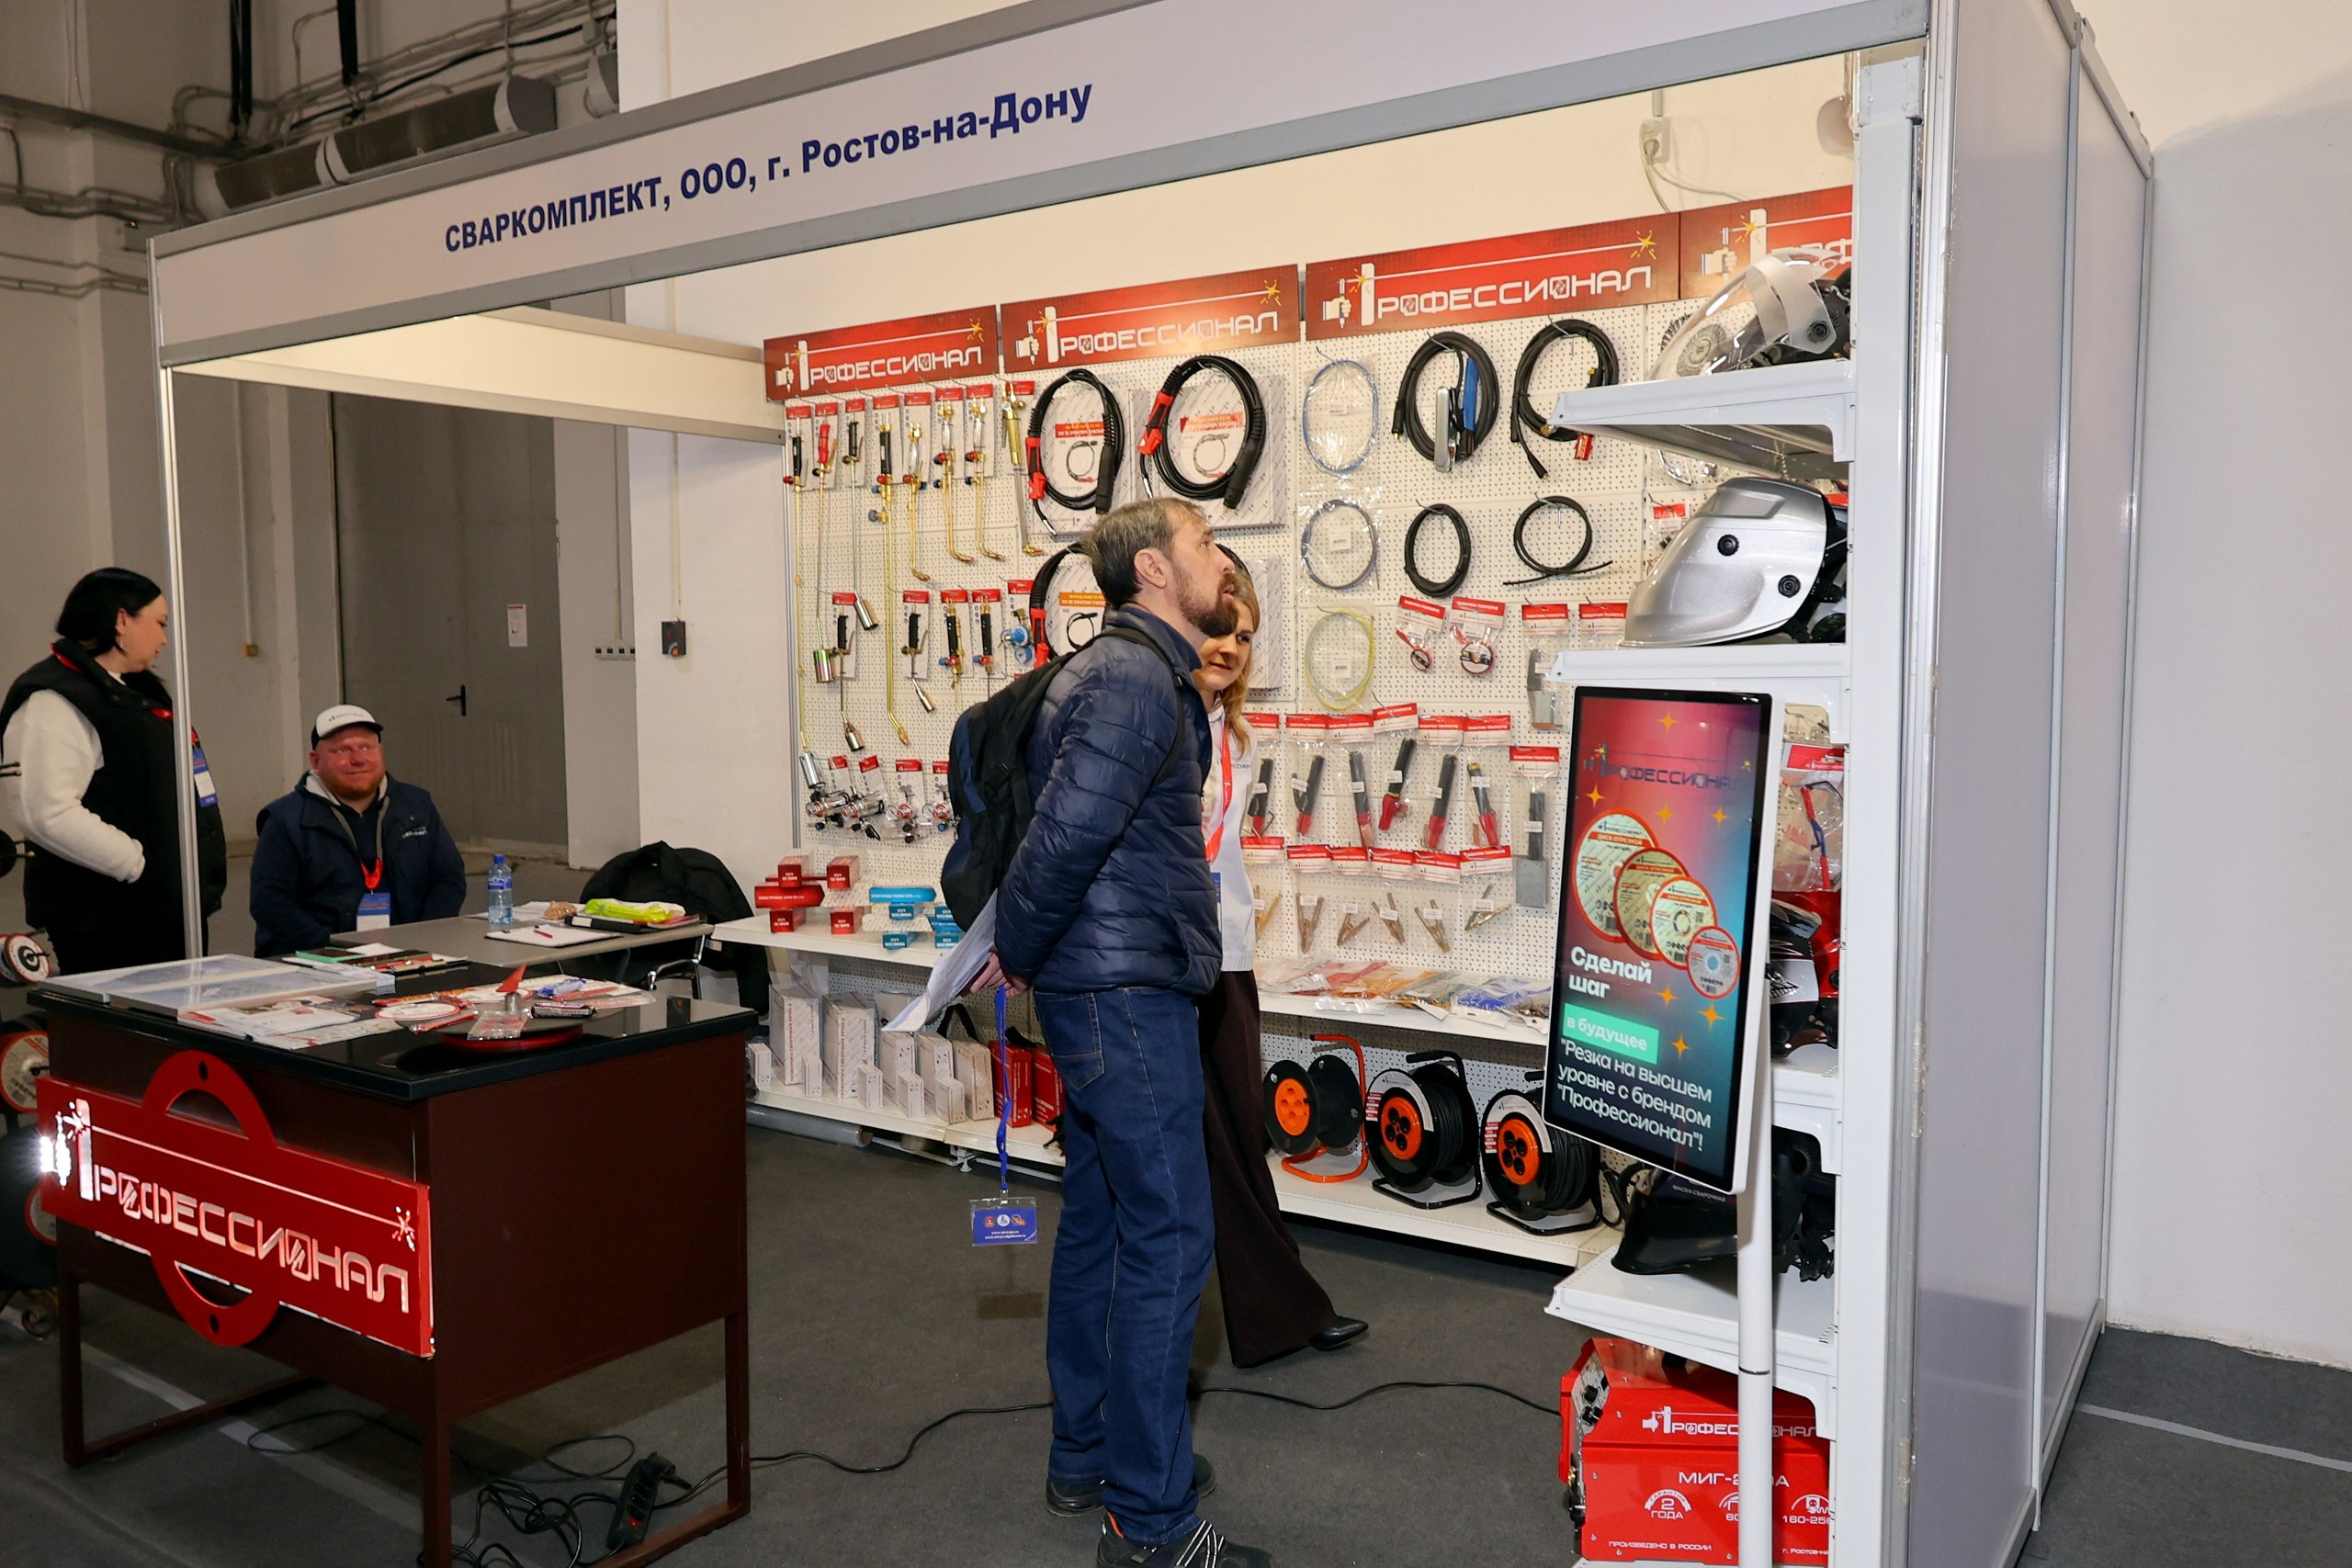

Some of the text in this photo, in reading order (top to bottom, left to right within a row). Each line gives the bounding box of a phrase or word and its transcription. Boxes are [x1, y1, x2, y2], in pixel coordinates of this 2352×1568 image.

[445, 84, 1092, 253] СВАРКОМПЛЕКТ, ООО, г. Ростов-на-Дону
[1584, 741, 1746, 792] ПРОФЕССИОНА
[1571, 946, 1652, 984] Сделай
[1568, 974, 1610, 998] шаг
[1566, 1016, 1647, 1051] в будущее
[1561, 1037, 1713, 1102] "Резка на высшем
[1558, 1064, 1711, 1129] уровне с брендом
[1557, 1083, 1703, 1152] "Профессионал"!
[1651, 1510, 1684, 1520] ГОДА
[1660, 1498, 1675, 1511] 2
[1609, 1540, 1668, 1551] ПРОИЗВЕДЕНО
[1678, 1542, 1712, 1551] РОССИИ
